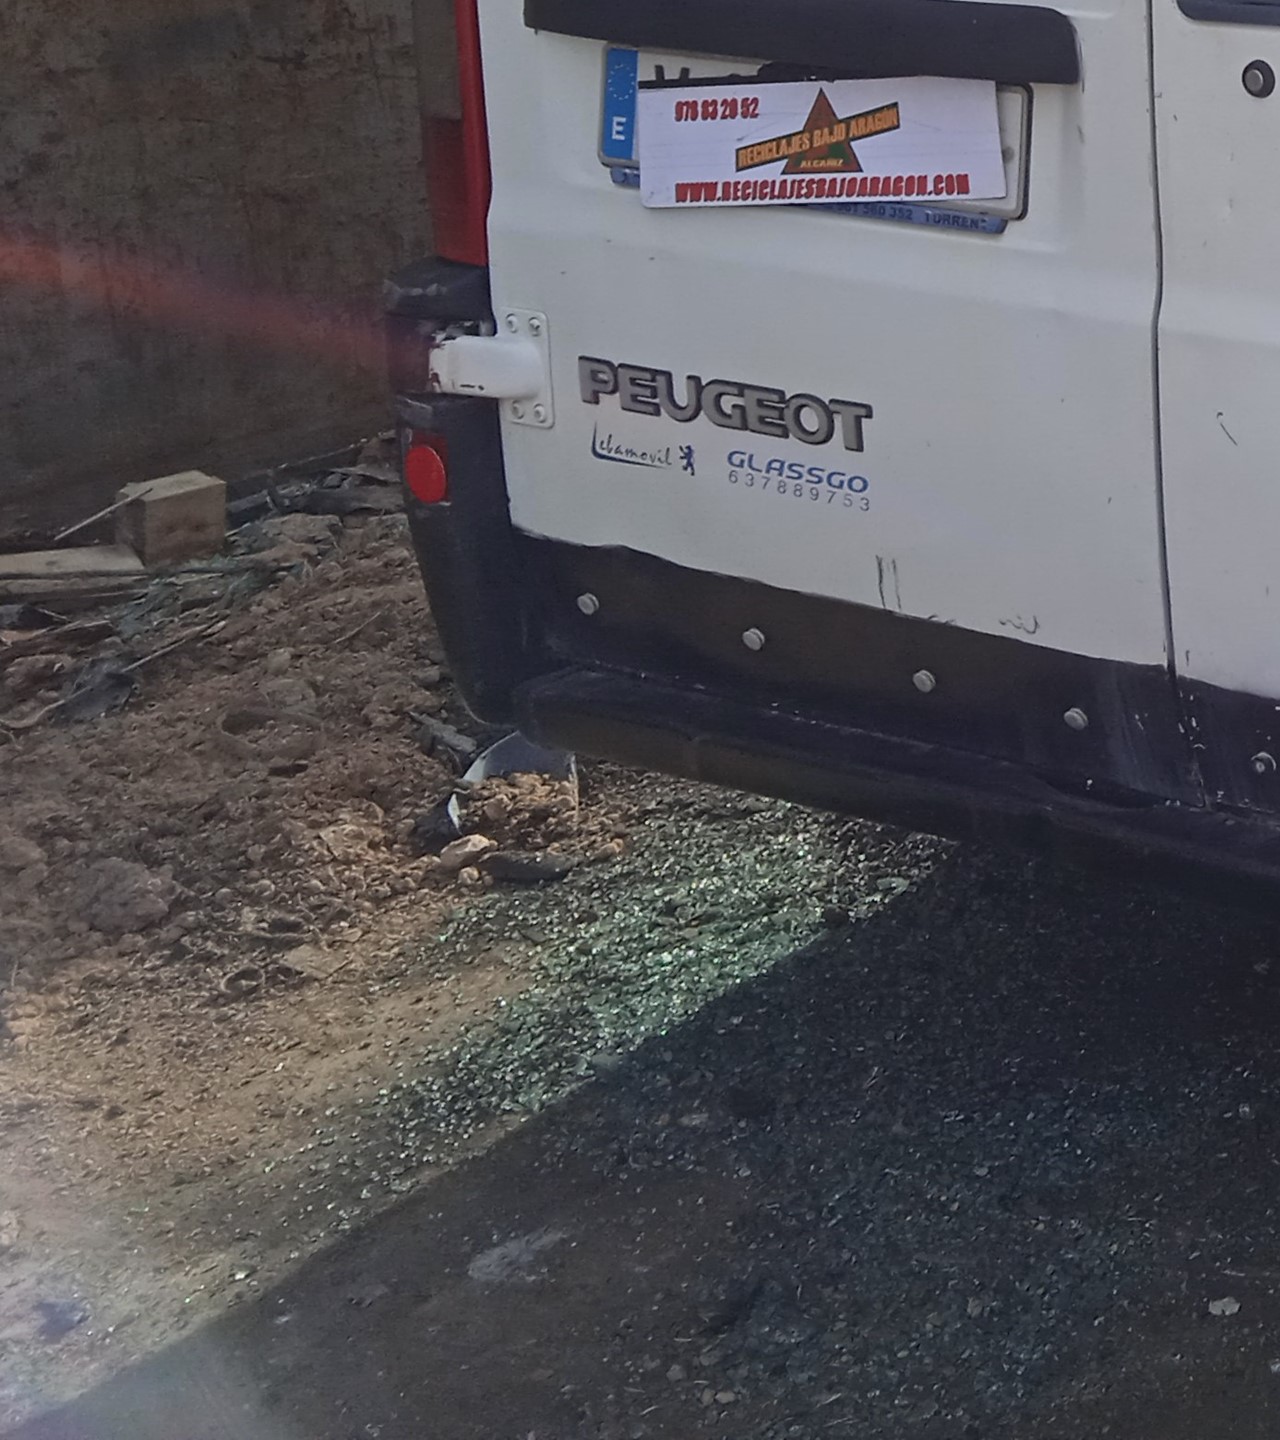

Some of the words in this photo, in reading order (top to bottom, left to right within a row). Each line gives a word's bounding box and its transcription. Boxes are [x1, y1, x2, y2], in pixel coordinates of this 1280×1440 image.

[611, 115, 627, 141] E
[740, 96, 760, 119] 52
[738, 131, 811, 168] RECICLAJES
[812, 122, 847, 148] BAJO
[577, 355, 874, 453] PEUGEOT
[727, 450, 869, 494] GLASSGO
[728, 469, 870, 512] 637889753
